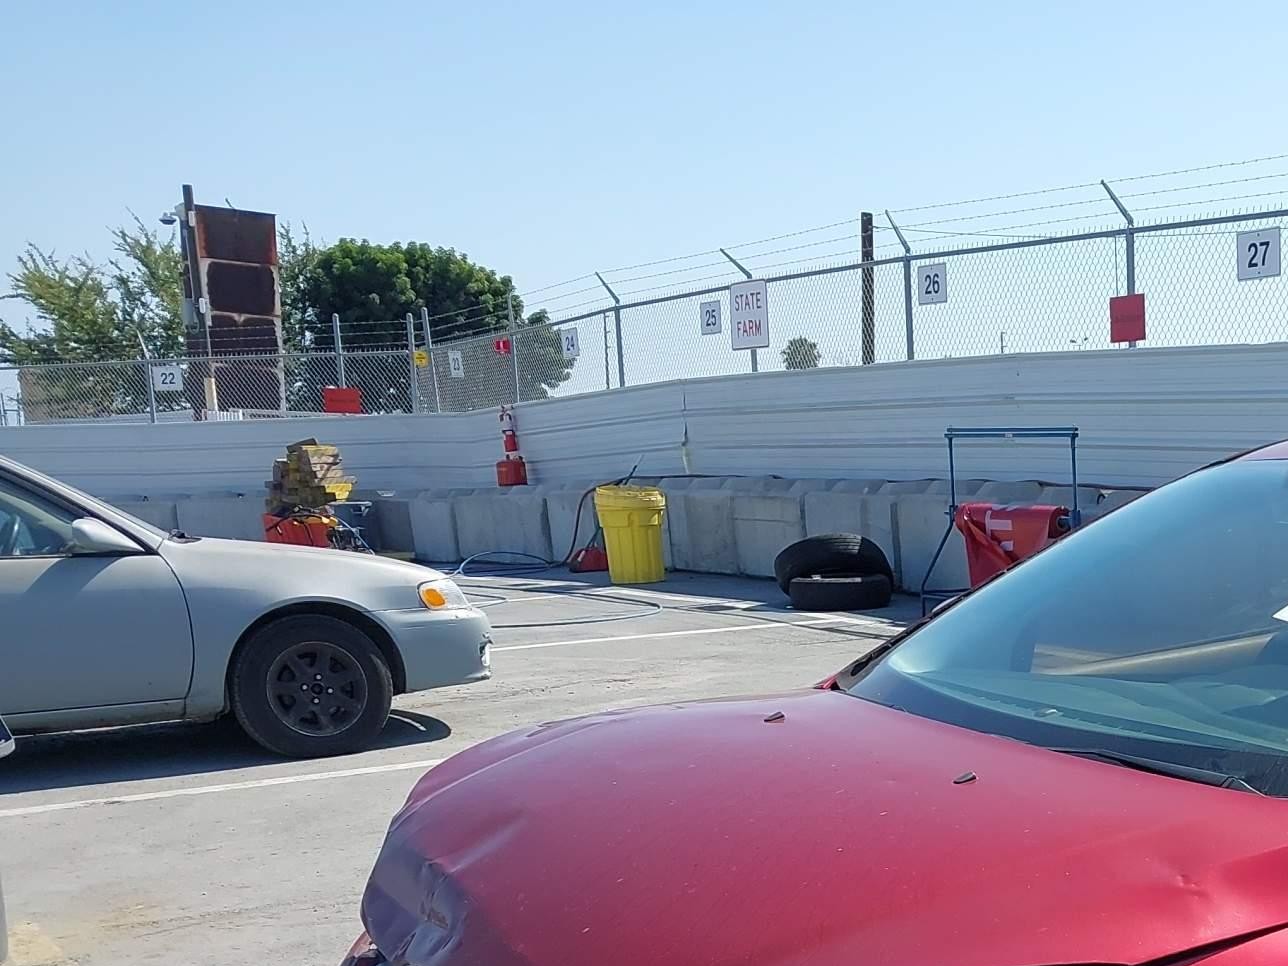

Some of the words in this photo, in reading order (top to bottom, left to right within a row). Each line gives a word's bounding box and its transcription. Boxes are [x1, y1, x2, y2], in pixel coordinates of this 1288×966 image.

[1247, 240, 1270, 268] 27
[924, 273, 940, 295] 26
[734, 292, 762, 312] STATE
[705, 309, 717, 327] 25
[736, 319, 762, 339] FARM
[565, 336, 575, 352] 24
[160, 372, 177, 385] 22
